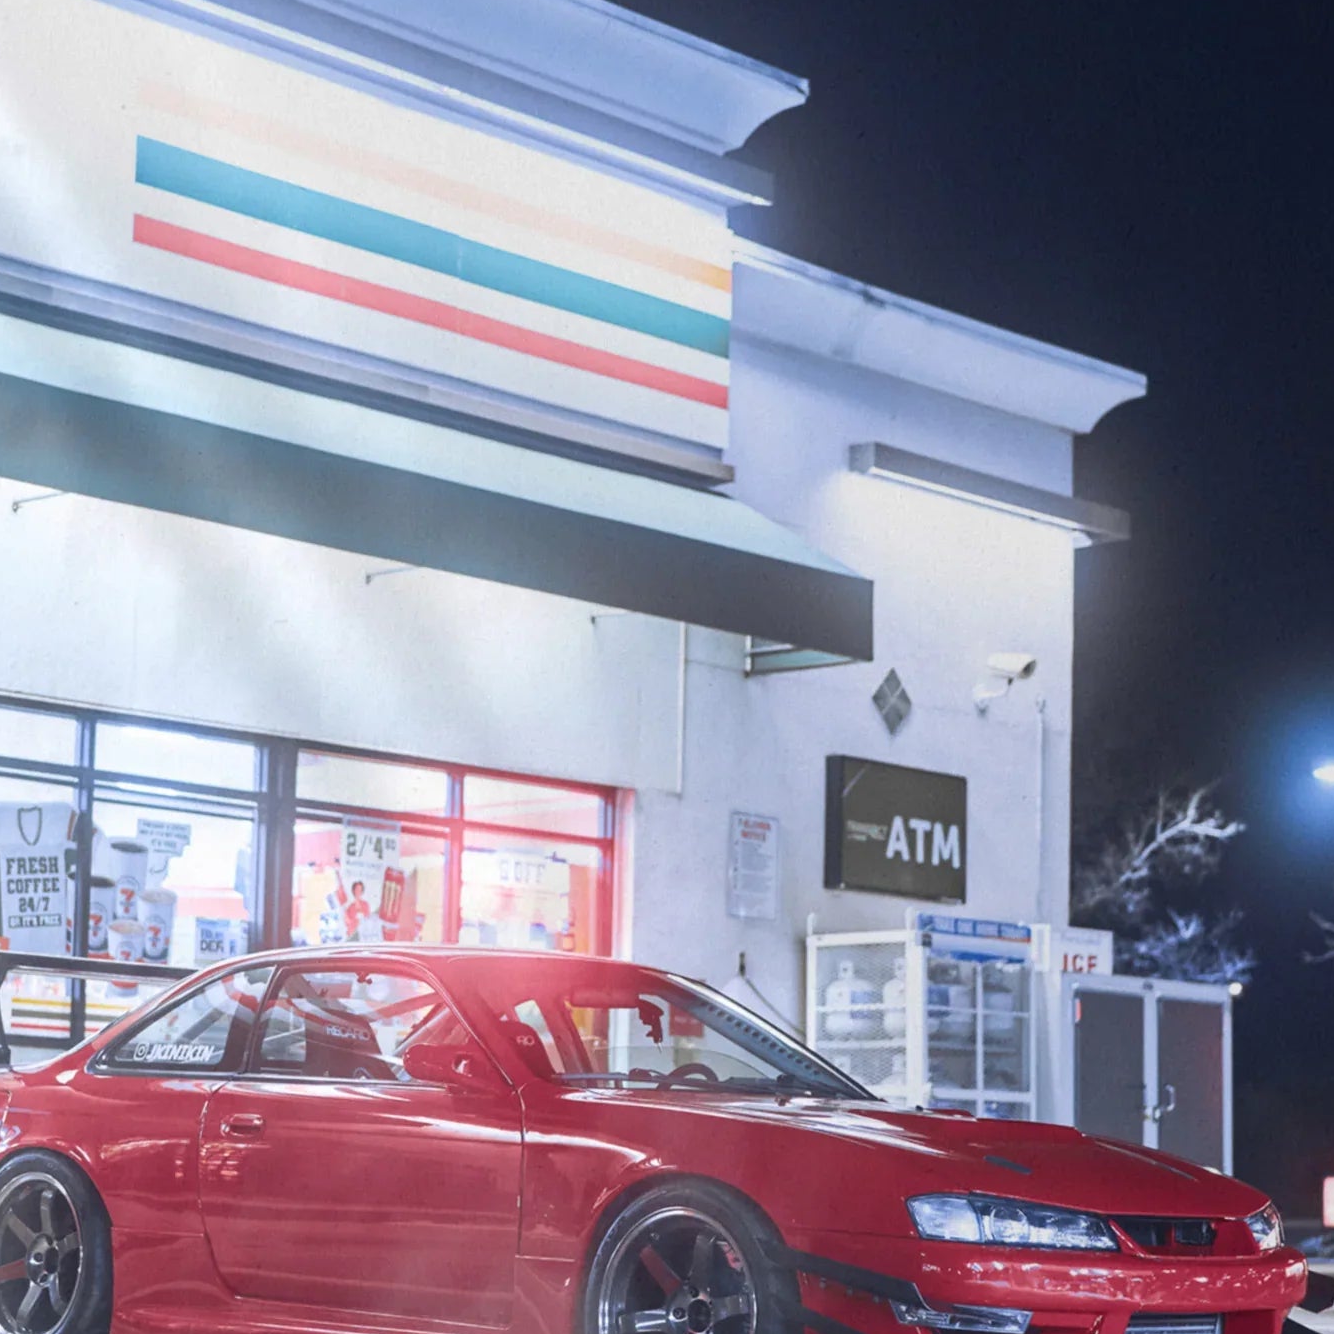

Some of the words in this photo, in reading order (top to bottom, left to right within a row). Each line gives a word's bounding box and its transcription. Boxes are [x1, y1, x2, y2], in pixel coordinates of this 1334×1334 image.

[885, 815, 960, 870] ATM
[6, 856, 59, 875] FRESH
[7, 877, 60, 894] COFFEE
[18, 896, 50, 913] 24/7
[1062, 953, 1098, 973] ICE
[326, 1025, 370, 1041] RECARO
